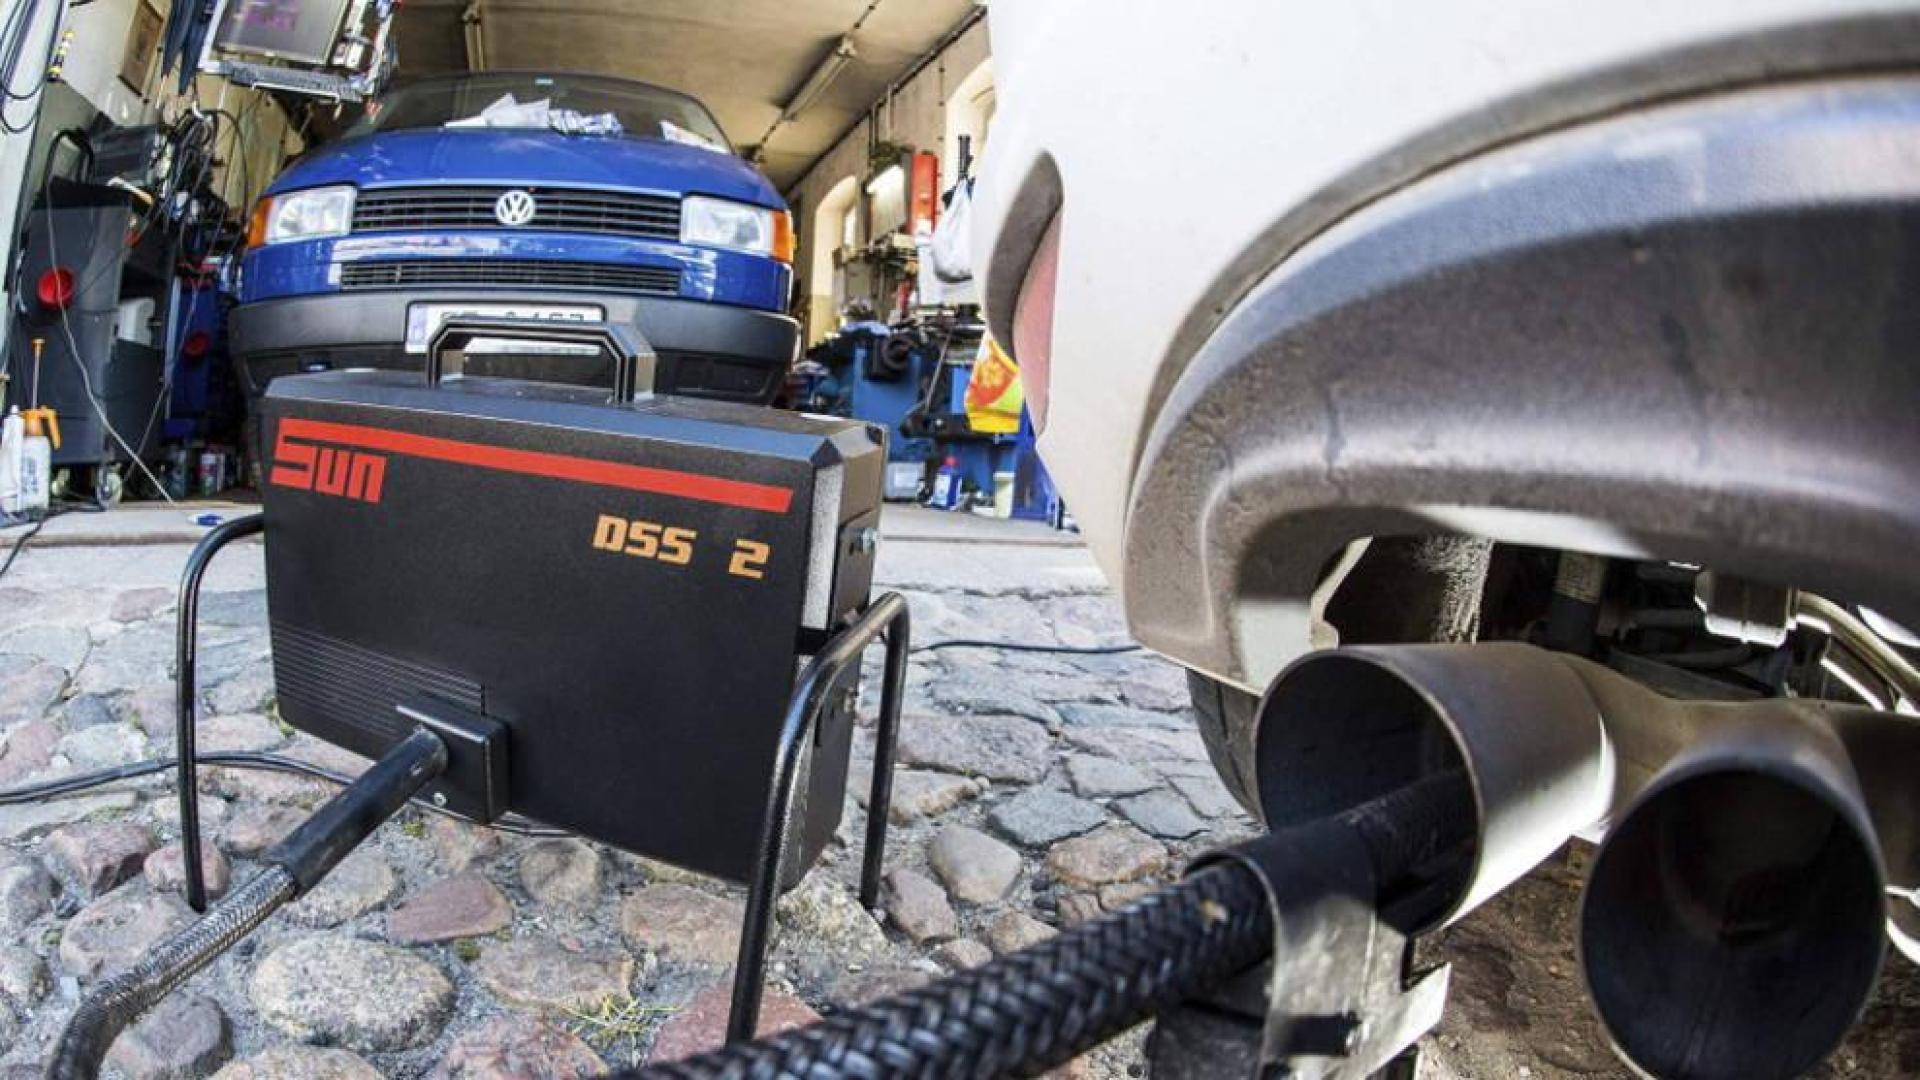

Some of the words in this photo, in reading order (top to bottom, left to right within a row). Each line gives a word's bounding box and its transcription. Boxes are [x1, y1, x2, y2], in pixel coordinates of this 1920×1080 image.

[497, 190, 534, 225] VW
[592, 513, 698, 565] DSS
[728, 538, 771, 579] 2
